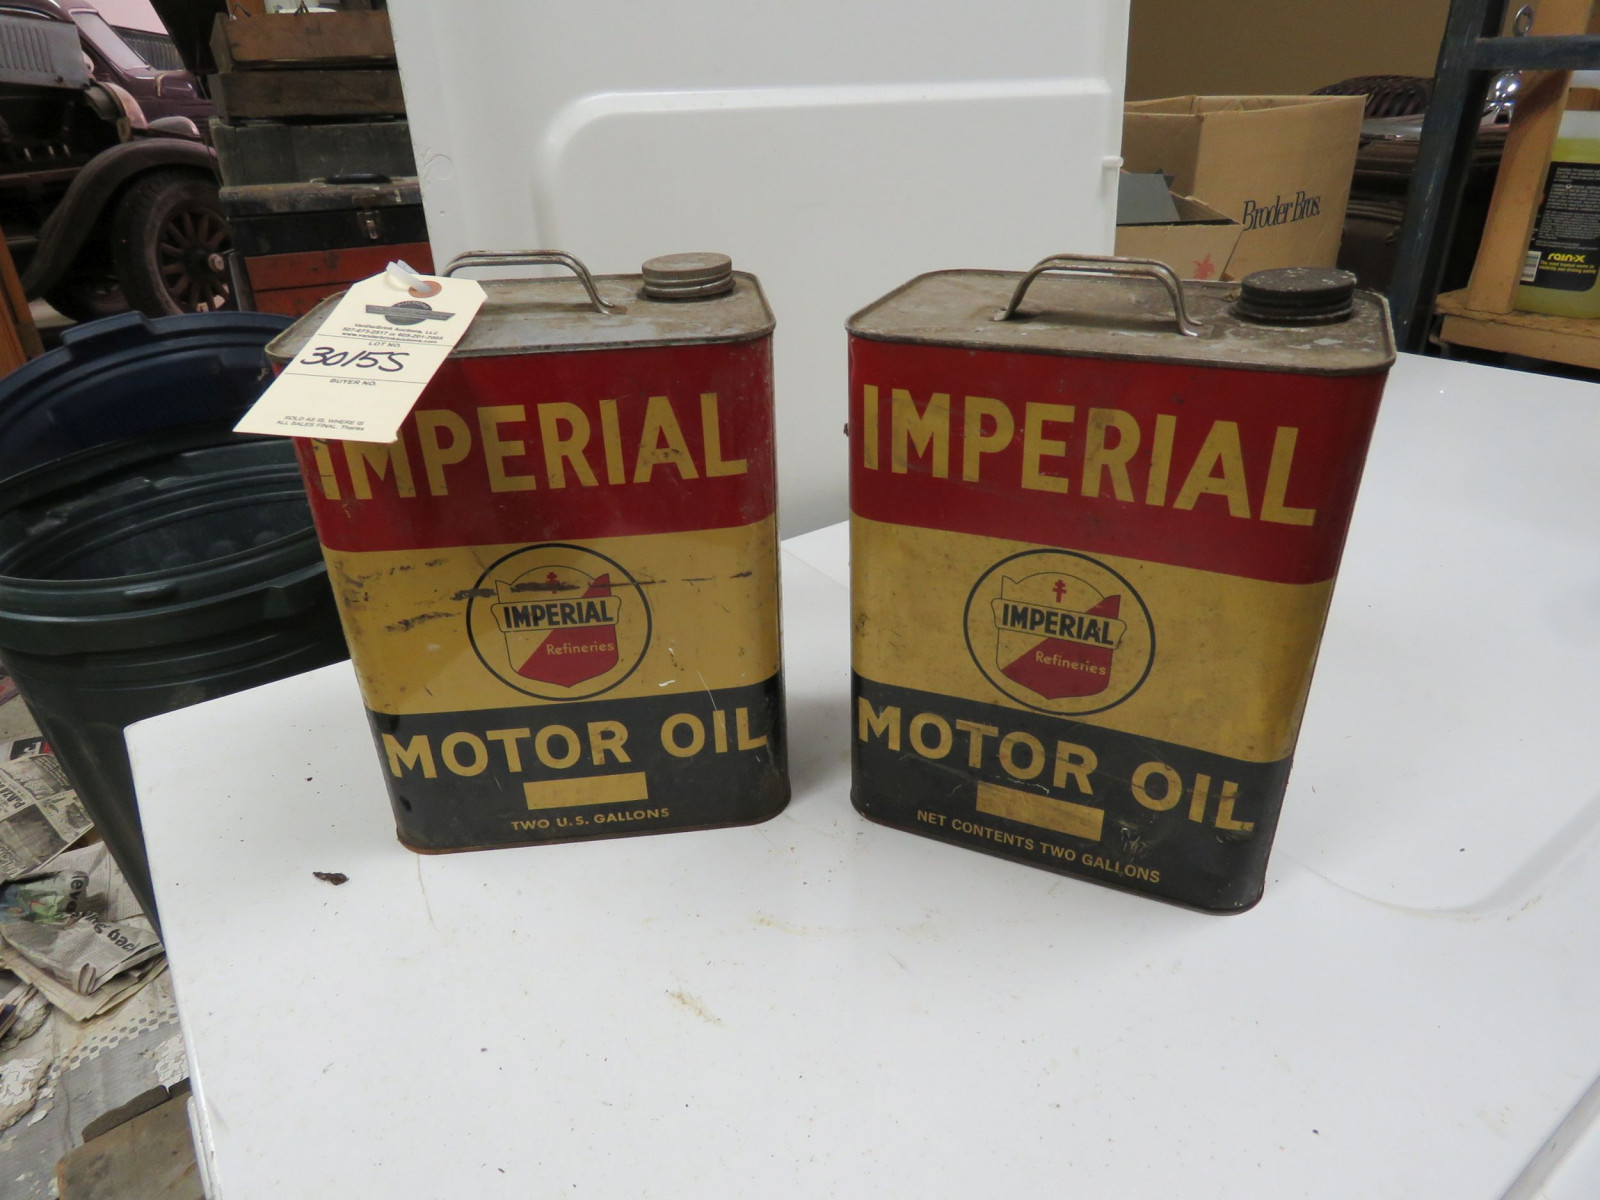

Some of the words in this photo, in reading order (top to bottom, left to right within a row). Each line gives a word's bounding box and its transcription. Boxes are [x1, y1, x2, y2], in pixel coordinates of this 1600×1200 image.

[1242, 195, 1294, 231] Broder
[310, 392, 748, 500] IMPERIAL
[863, 384, 1317, 526] IMPERIAL
[503, 600, 614, 629] IMPERIAL
[1002, 603, 1114, 646] IMPERIAL
[546, 640, 615, 656] Refineries
[1035, 650, 1106, 675] Refineries
[381, 720, 632, 779] MOTOR
[660, 707, 767, 758] OIL
[858, 697, 1099, 795] MOTOR
[1131, 761, 1255, 832] OIL
[511, 819, 550, 831] TWO
[594, 807, 670, 824] GALLONS
[917, 809, 947, 826] NET
[951, 818, 1034, 851] CONTENTS
[1040, 841, 1076, 861] TWO
[1082, 853, 1160, 883] GALLONS
